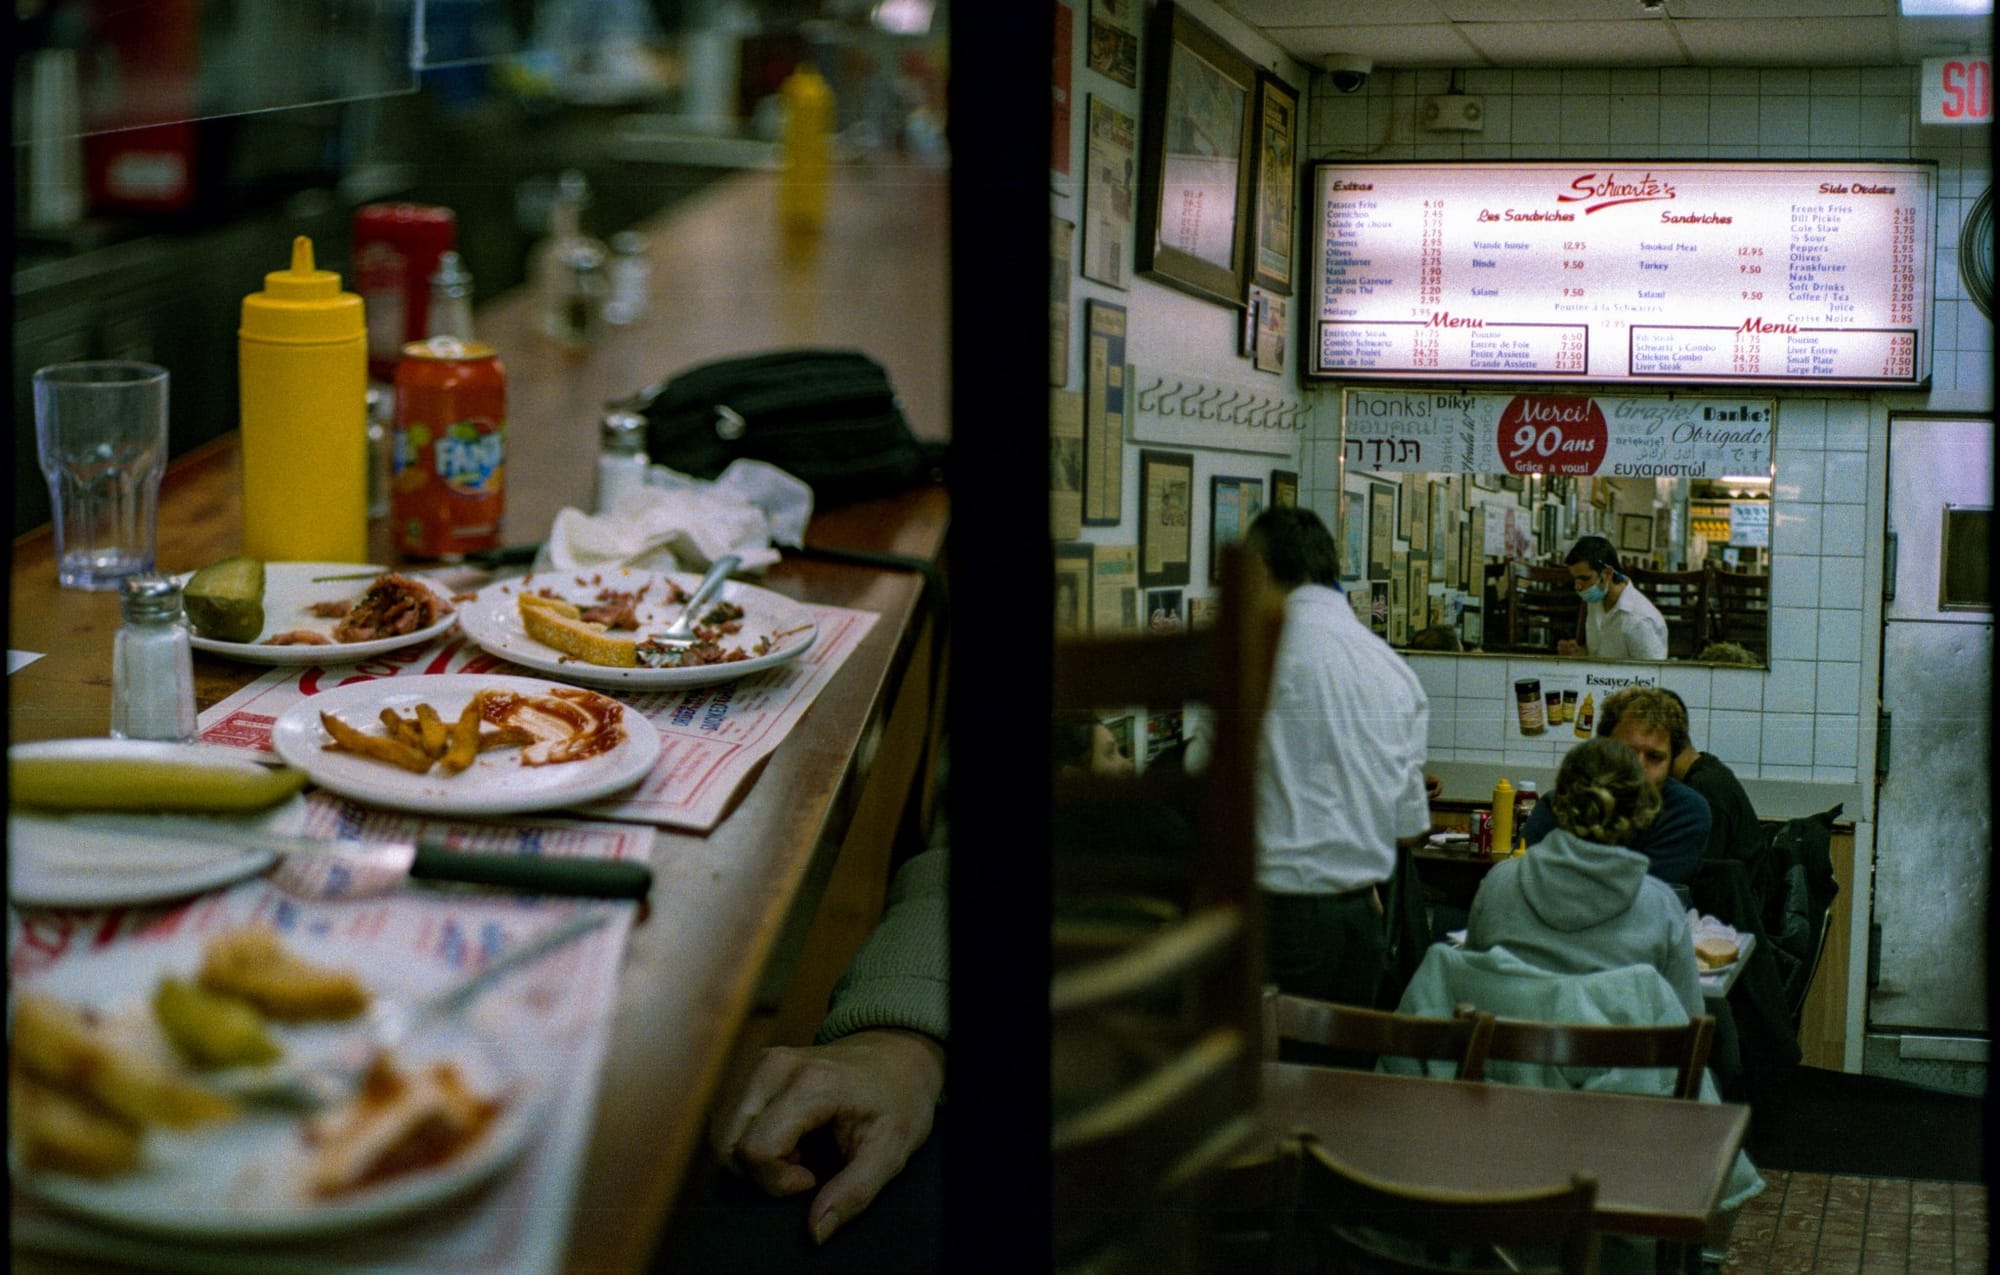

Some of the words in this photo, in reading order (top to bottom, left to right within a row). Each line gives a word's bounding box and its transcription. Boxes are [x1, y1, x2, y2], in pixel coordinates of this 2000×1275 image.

[1942, 60, 1989, 117] SO
[1332, 180, 1374, 191] Extras
[1557, 173, 1676, 203] Schwartz's
[1819, 183, 1848, 194] Side
[1852, 184, 1896, 194] Orders
[1424, 200, 1444, 208] 4.10
[1327, 211, 1370, 219] Cornichon
[1424, 210, 1443, 218] 2.45
[1477, 209, 1500, 222] Les
[1504, 209, 1575, 222] Sandwiches
[1792, 205, 1824, 213] French
[1828, 205, 1852, 213] Fries
[1894, 208, 1916, 216] 4.10
[1660, 210, 1732, 224] Sandwiches
[1792, 214, 1808, 222] Dill
[1812, 214, 1840, 222] Pickle
[1894, 216, 1915, 224] 2.45
[1423, 230, 1442, 238] 2.75
[1791, 224, 1812, 232] Cole
[1818, 224, 1838, 232] Slaw
[1894, 226, 1914, 234] 3.75
[1422, 239, 1442, 247] 2.95
[1804, 234, 1826, 242] Sour
[1893, 236, 1915, 244] 2.75
[1563, 242, 1586, 250] 12.95
[1790, 244, 1828, 252] Peppers
[1892, 245, 1914, 254] 2.95
[1326, 248, 1352, 256] Olives
[1738, 248, 1764, 256] 12.95
[1326, 258, 1371, 266] Frankfurter
[1422, 258, 1442, 266] 2.75
[1790, 253, 1820, 262] Olives
[1892, 254, 1914, 263] 3.75
[1472, 260, 1496, 268] Dinde
[1563, 261, 1584, 270] 9.50
[1640, 261, 1668, 271] Turkey
[1740, 265, 1762, 274] 9.50
[1790, 263, 1846, 272] Frankfurter
[1892, 264, 1914, 274] 2.75
[1326, 268, 1346, 276] Nash
[1422, 268, 1442, 276] 1.90
[1420, 277, 1442, 285] 2.95
[1790, 273, 1814, 282] Nash
[1893, 274, 1914, 282] 1.90
[1421, 286, 1442, 294] 2.20
[1789, 282, 1808, 291] Soft
[1812, 283, 1845, 292] Drinks
[1892, 283, 1914, 292] 2.95
[1564, 288, 1584, 297] 9.50
[1742, 291, 1763, 300] 9.50
[1789, 292, 1820, 301] Coffee
[1833, 293, 1849, 302] Tea
[1892, 294, 1914, 302] 2.20
[1420, 296, 1441, 304] 2.95
[1830, 303, 1854, 312] Juice
[1891, 304, 1913, 312] 2.95
[1424, 312, 1484, 328] Menu
[1892, 315, 1912, 324] 2.95
[1736, 316, 1798, 334] Menu
[1562, 342, 1582, 350] 7.50
[1891, 337, 1912, 346] 6.50
[1470, 350, 1494, 358] Petite
[1497, 350, 1530, 358] Assiette
[1556, 352, 1582, 360] 17.50
[1890, 347, 1912, 356] 7.50
[1636, 353, 1670, 361] Chicken
[1672, 353, 1702, 361] Combo
[1787, 356, 1810, 364] Small
[1813, 356, 1834, 364] Plate
[1886, 357, 1911, 366] 17.50
[1413, 358, 1438, 367] 15.75
[1470, 360, 1500, 368] Grande
[1504, 360, 1537, 368] Assiette
[1556, 360, 1582, 369] 21.25
[1636, 363, 1656, 371] Liver
[1659, 363, 1682, 372] Steak
[1734, 364, 1760, 373] 15.75
[1787, 366, 1810, 374] Large
[1813, 366, 1834, 374] Plate
[1883, 367, 1910, 376] 21.25
[1437, 395, 1476, 413] Díky!
[1514, 398, 1592, 424] Merci!
[1704, 406, 1770, 422] Danke!
[1614, 399, 1699, 435] Grazie!
[1672, 422, 1771, 448] Obrigado!
[1510, 425, 1562, 458] 90
[1562, 439, 1595, 452] ans
[1562, 462, 1588, 473] vous!
[1614, 461, 1706, 479] ευχαριστώ!
[1586, 674, 1655, 689] Essayez-les!
